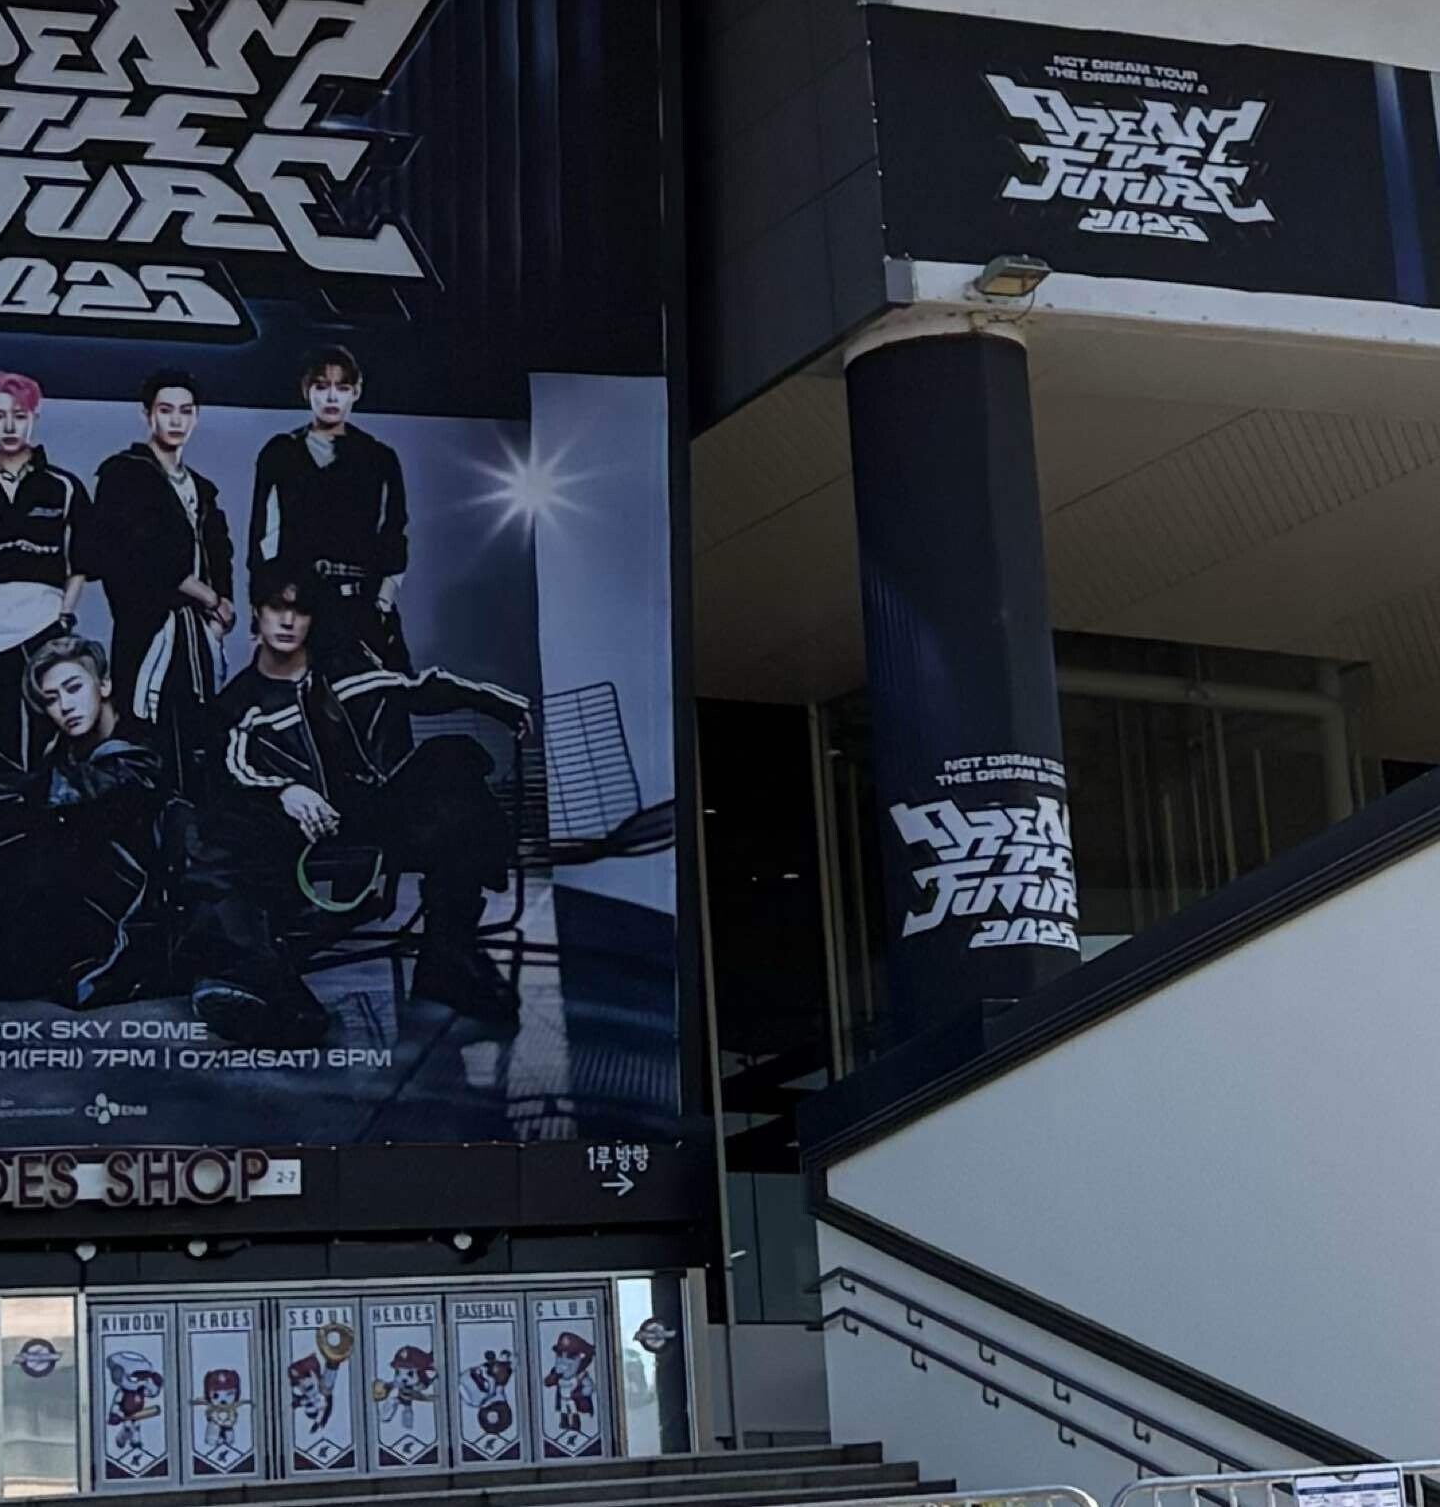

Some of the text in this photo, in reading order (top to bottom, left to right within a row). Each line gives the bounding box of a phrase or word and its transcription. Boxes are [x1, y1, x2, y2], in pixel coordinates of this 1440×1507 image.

[1045, 66, 1078, 80] THE
[1081, 70, 1141, 85] DREAM
[1144, 77, 1194, 92] SHOW
[1092, 59, 1151, 74] DREAM
[1154, 66, 1198, 81] TOUR
[986, 74, 1266, 164] DREAM
[1105, 143, 1202, 176] THE
[1002, 144, 1276, 223] FUTURE
[1077, 209, 1209, 242] 2025
[51, 1020, 111, 1040] SKY
[121, 1021, 208, 1040] DOME
[92, 1050, 155, 1068] 7PM
[327, 1049, 392, 1067] 6PM
[587, 1144, 649, 1172] 1루 방향
[101, 1149, 270, 1208] SHOP
[102, 1311, 251, 1332] KIWOOM HEROES
[289, 1308, 350, 1325] SEOUL
[372, 1303, 434, 1321] HEROES
